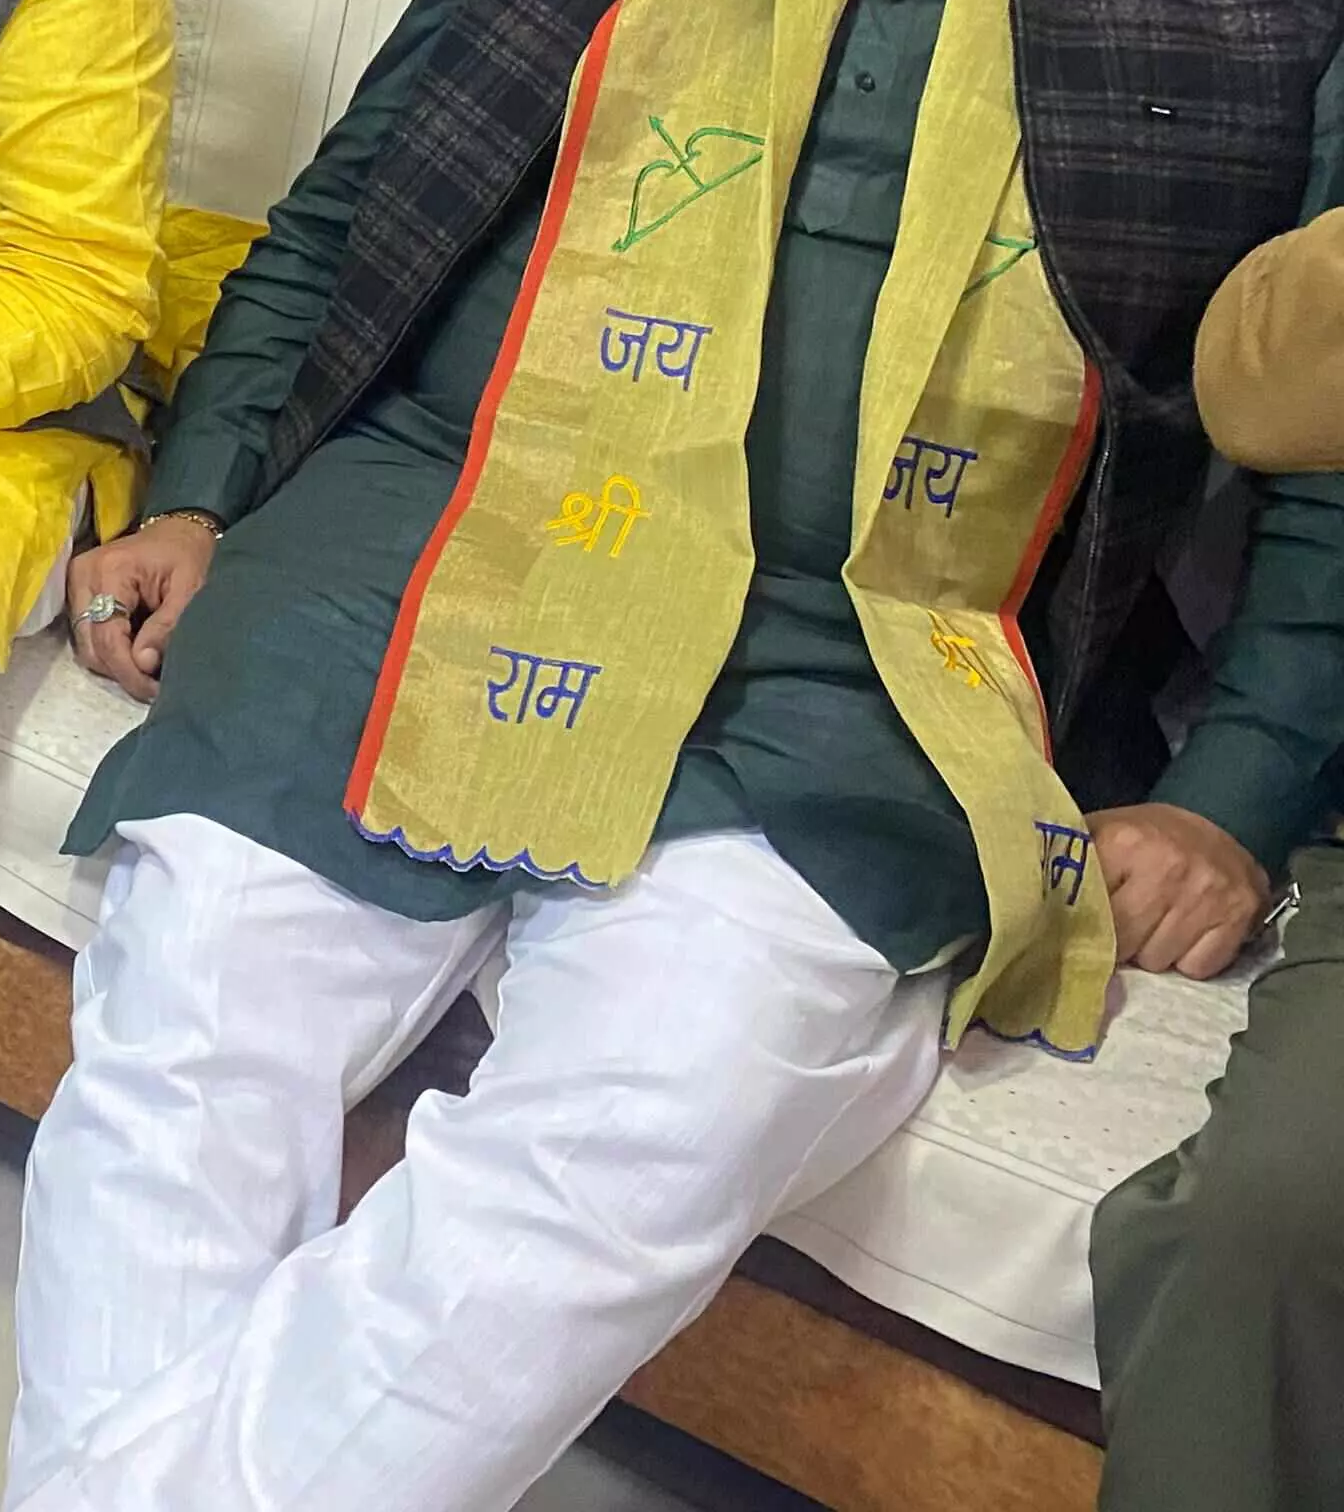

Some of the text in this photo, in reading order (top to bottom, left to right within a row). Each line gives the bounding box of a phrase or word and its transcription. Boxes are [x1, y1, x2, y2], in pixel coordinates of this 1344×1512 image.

[599, 306, 713, 391] जय
[545, 474, 652, 558] श्री
[486, 645, 603, 730] राम
